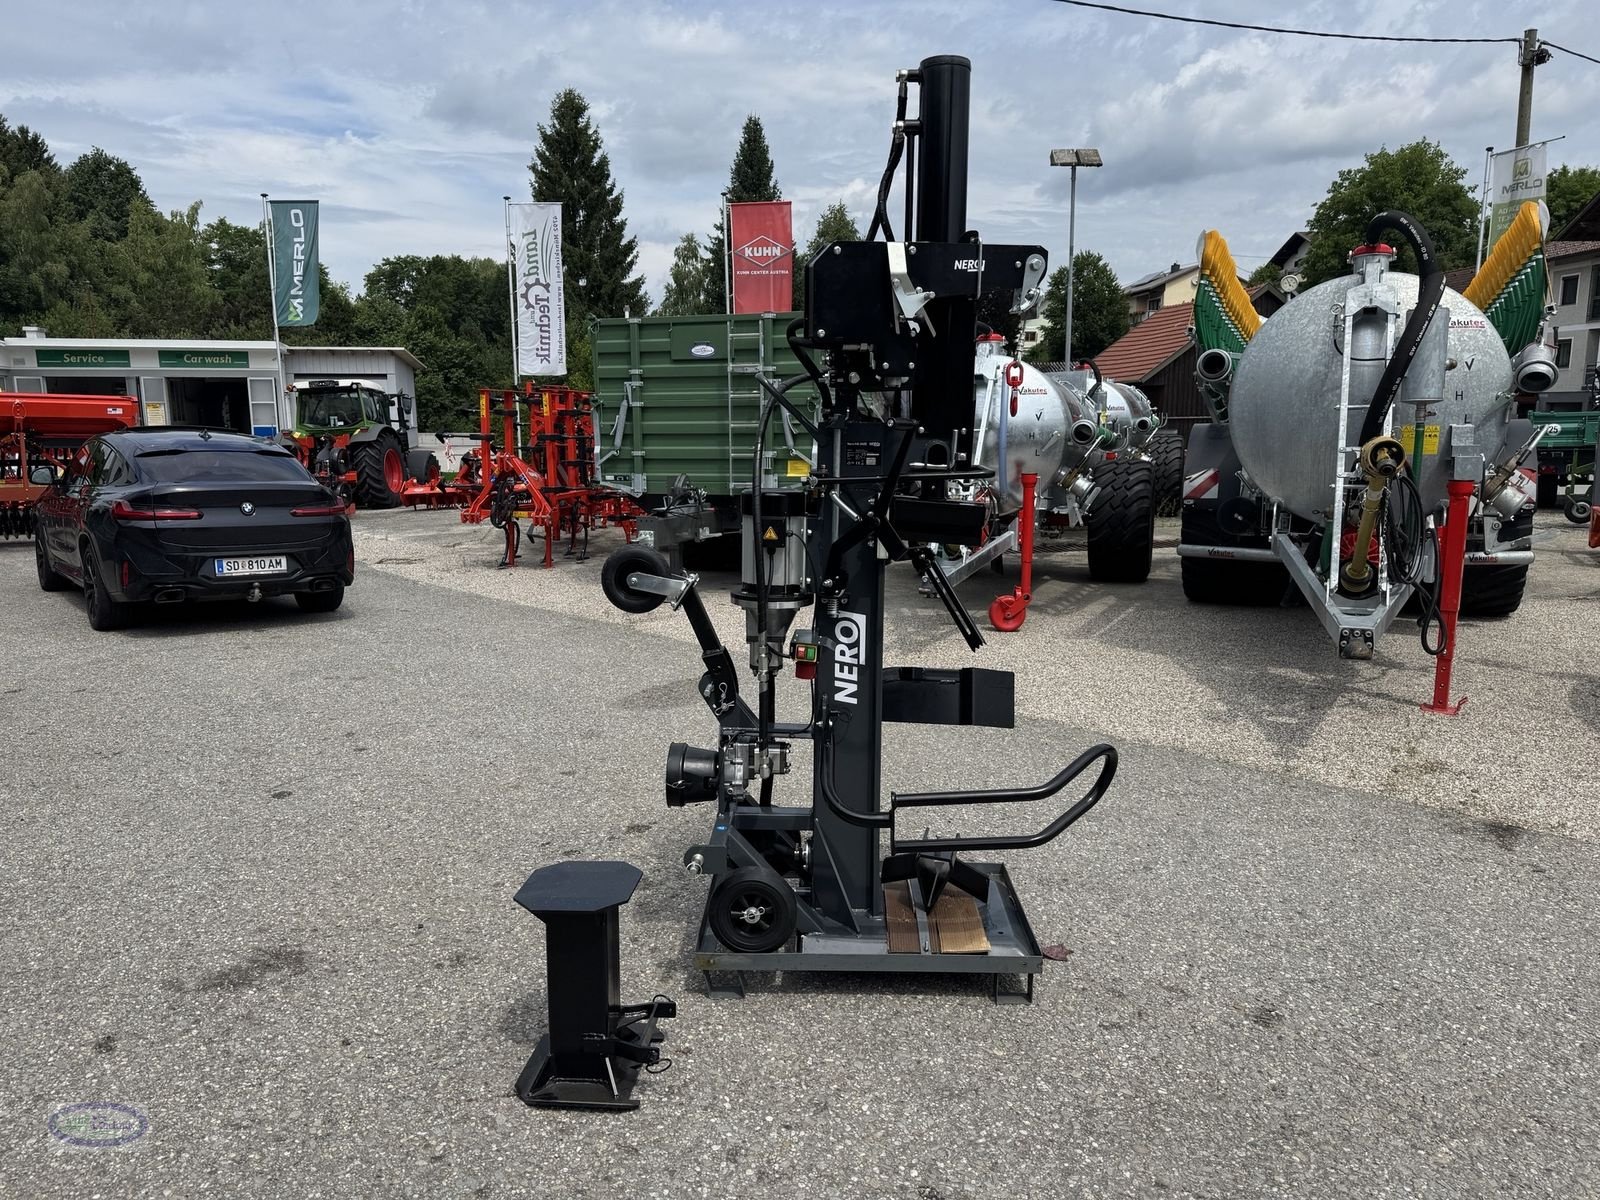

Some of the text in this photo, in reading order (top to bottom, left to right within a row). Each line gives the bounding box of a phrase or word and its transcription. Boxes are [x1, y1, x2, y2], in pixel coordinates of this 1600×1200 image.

[1502, 179, 1543, 195] MERLO
[290, 208, 305, 295] MERLO
[744, 246, 781, 257] KUHN
[63, 353, 104, 363] Service
[184, 354, 232, 364] Car wash
[1465, 358, 1475, 371] V
[1018, 386, 1048, 395] Vakutec
[1455, 390, 1464, 401] H
[1465, 414, 1472, 424] L
[1548, 426, 1559, 434] 25
[1028, 432, 1035, 440] H
[226, 558, 282, 571] SD 810 AM
[834, 620, 859, 705] NERO
